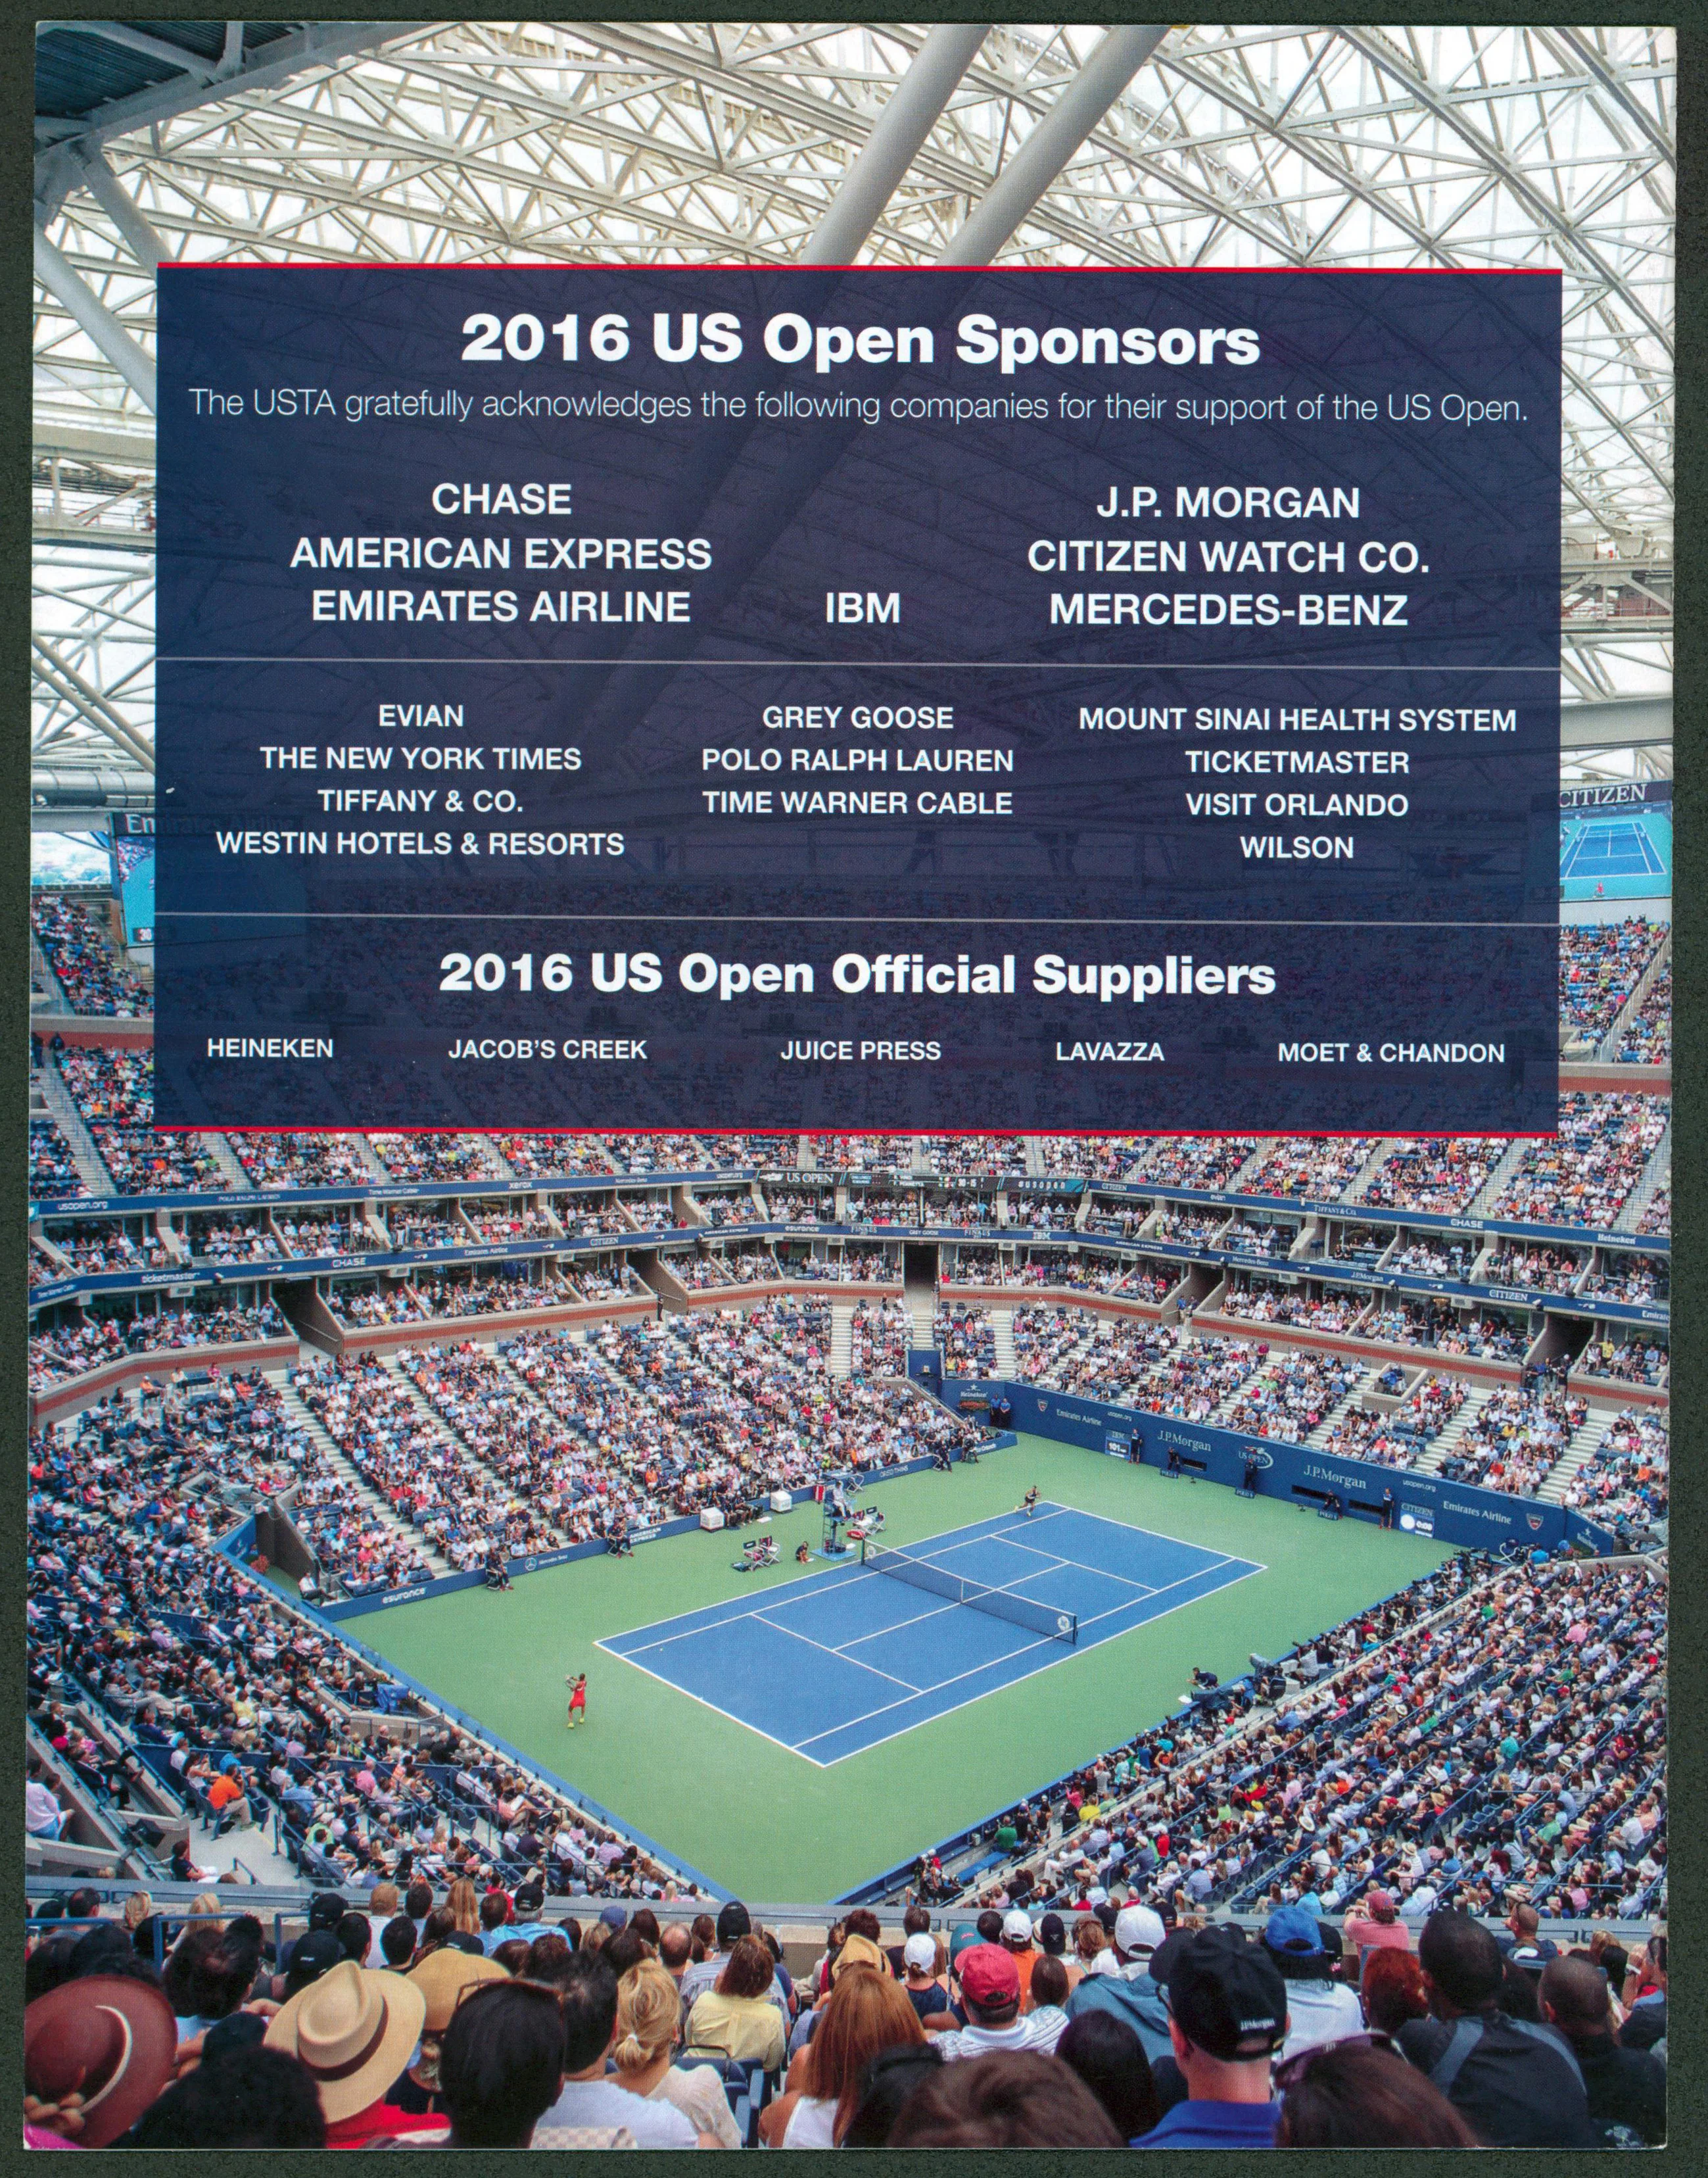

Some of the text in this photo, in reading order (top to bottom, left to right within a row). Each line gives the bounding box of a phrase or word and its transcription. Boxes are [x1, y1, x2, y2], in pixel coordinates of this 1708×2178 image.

[462, 312, 1260, 374] 2016 US Open Sponsors
[189, 389, 1529, 426] The USTA gratefully acknowledges the following companies for their support of the US Open.
[433, 483, 571, 514] CHASE
[1097, 487, 1359, 518] J.P. MORGAN
[290, 537, 712, 569] AMERICAN EXPRESS
[1028, 540, 1429, 573] CITIZEN WATCH CO.
[313, 590, 690, 621] EMIRATES AIRLINE
[827, 593, 899, 623] IBM
[1051, 593, 1408, 625] MERCEDES-BENZ
[379, 704, 463, 727] EVIAN
[763, 706, 953, 729] GREY GOOSE
[1080, 708, 1515, 731] MOUNT SINAI HEALTH SYSTEM
[260, 747, 581, 770] THE NEW YORK TIMES
[703, 748, 1012, 771] POLO RALPH LAUREN
[1185, 750, 1409, 773] TICKETMASTER
[318, 790, 522, 812] TIFFANY & CO.
[703, 791, 1012, 814] TIME WARNER CABLE
[1186, 793, 1408, 816] VISIT ORLANDO
[1559, 784, 1648, 809] CITIZEN
[216, 831, 624, 856] WESTIN HOTELS & RESORTS
[1240, 836, 1353, 858] WILSON
[440, 952, 1275, 1003] 2016 US Open Official Suppliers
[208, 1038, 332, 1058] HEINEKEN
[448, 1039, 647, 1059] JACOB'S CREEK
[781, 1041, 941, 1060] JUICE PRESS
[1057, 1042, 1164, 1061] LAVAZZA
[1279, 1043, 1504, 1063] MOET & CHANDON
[787, 1173, 834, 1184] US OPEN
[57, 1201, 108, 1211] usopen.org
[1450, 1218, 1484, 1229] CHASE
[590, 1237, 619, 1246] CITIZEN
[1032, 1231, 1051, 1240] IBM
[1598, 1233, 1636, 1246] Heineken
[331, 1257, 367, 1268] CHASE
[141, 1272, 197, 1284] ticketmaster
[1488, 1290, 1529, 1302] CITIZEN
[1056, 1409, 1103, 1426] Emirates Airline
[1157, 1430, 1212, 1452] J.P.Morgan
[1239, 1451, 1247, 1459] US
[1304, 1464, 1367, 1489] J.P.Morgan
[1402, 1480, 1436, 1493] usopen.org
[1401, 1503, 1435, 1517] CITIZEN
[1443, 1501, 1512, 1525] Emirates Airline
[382, 1587, 426, 1604] esurance
